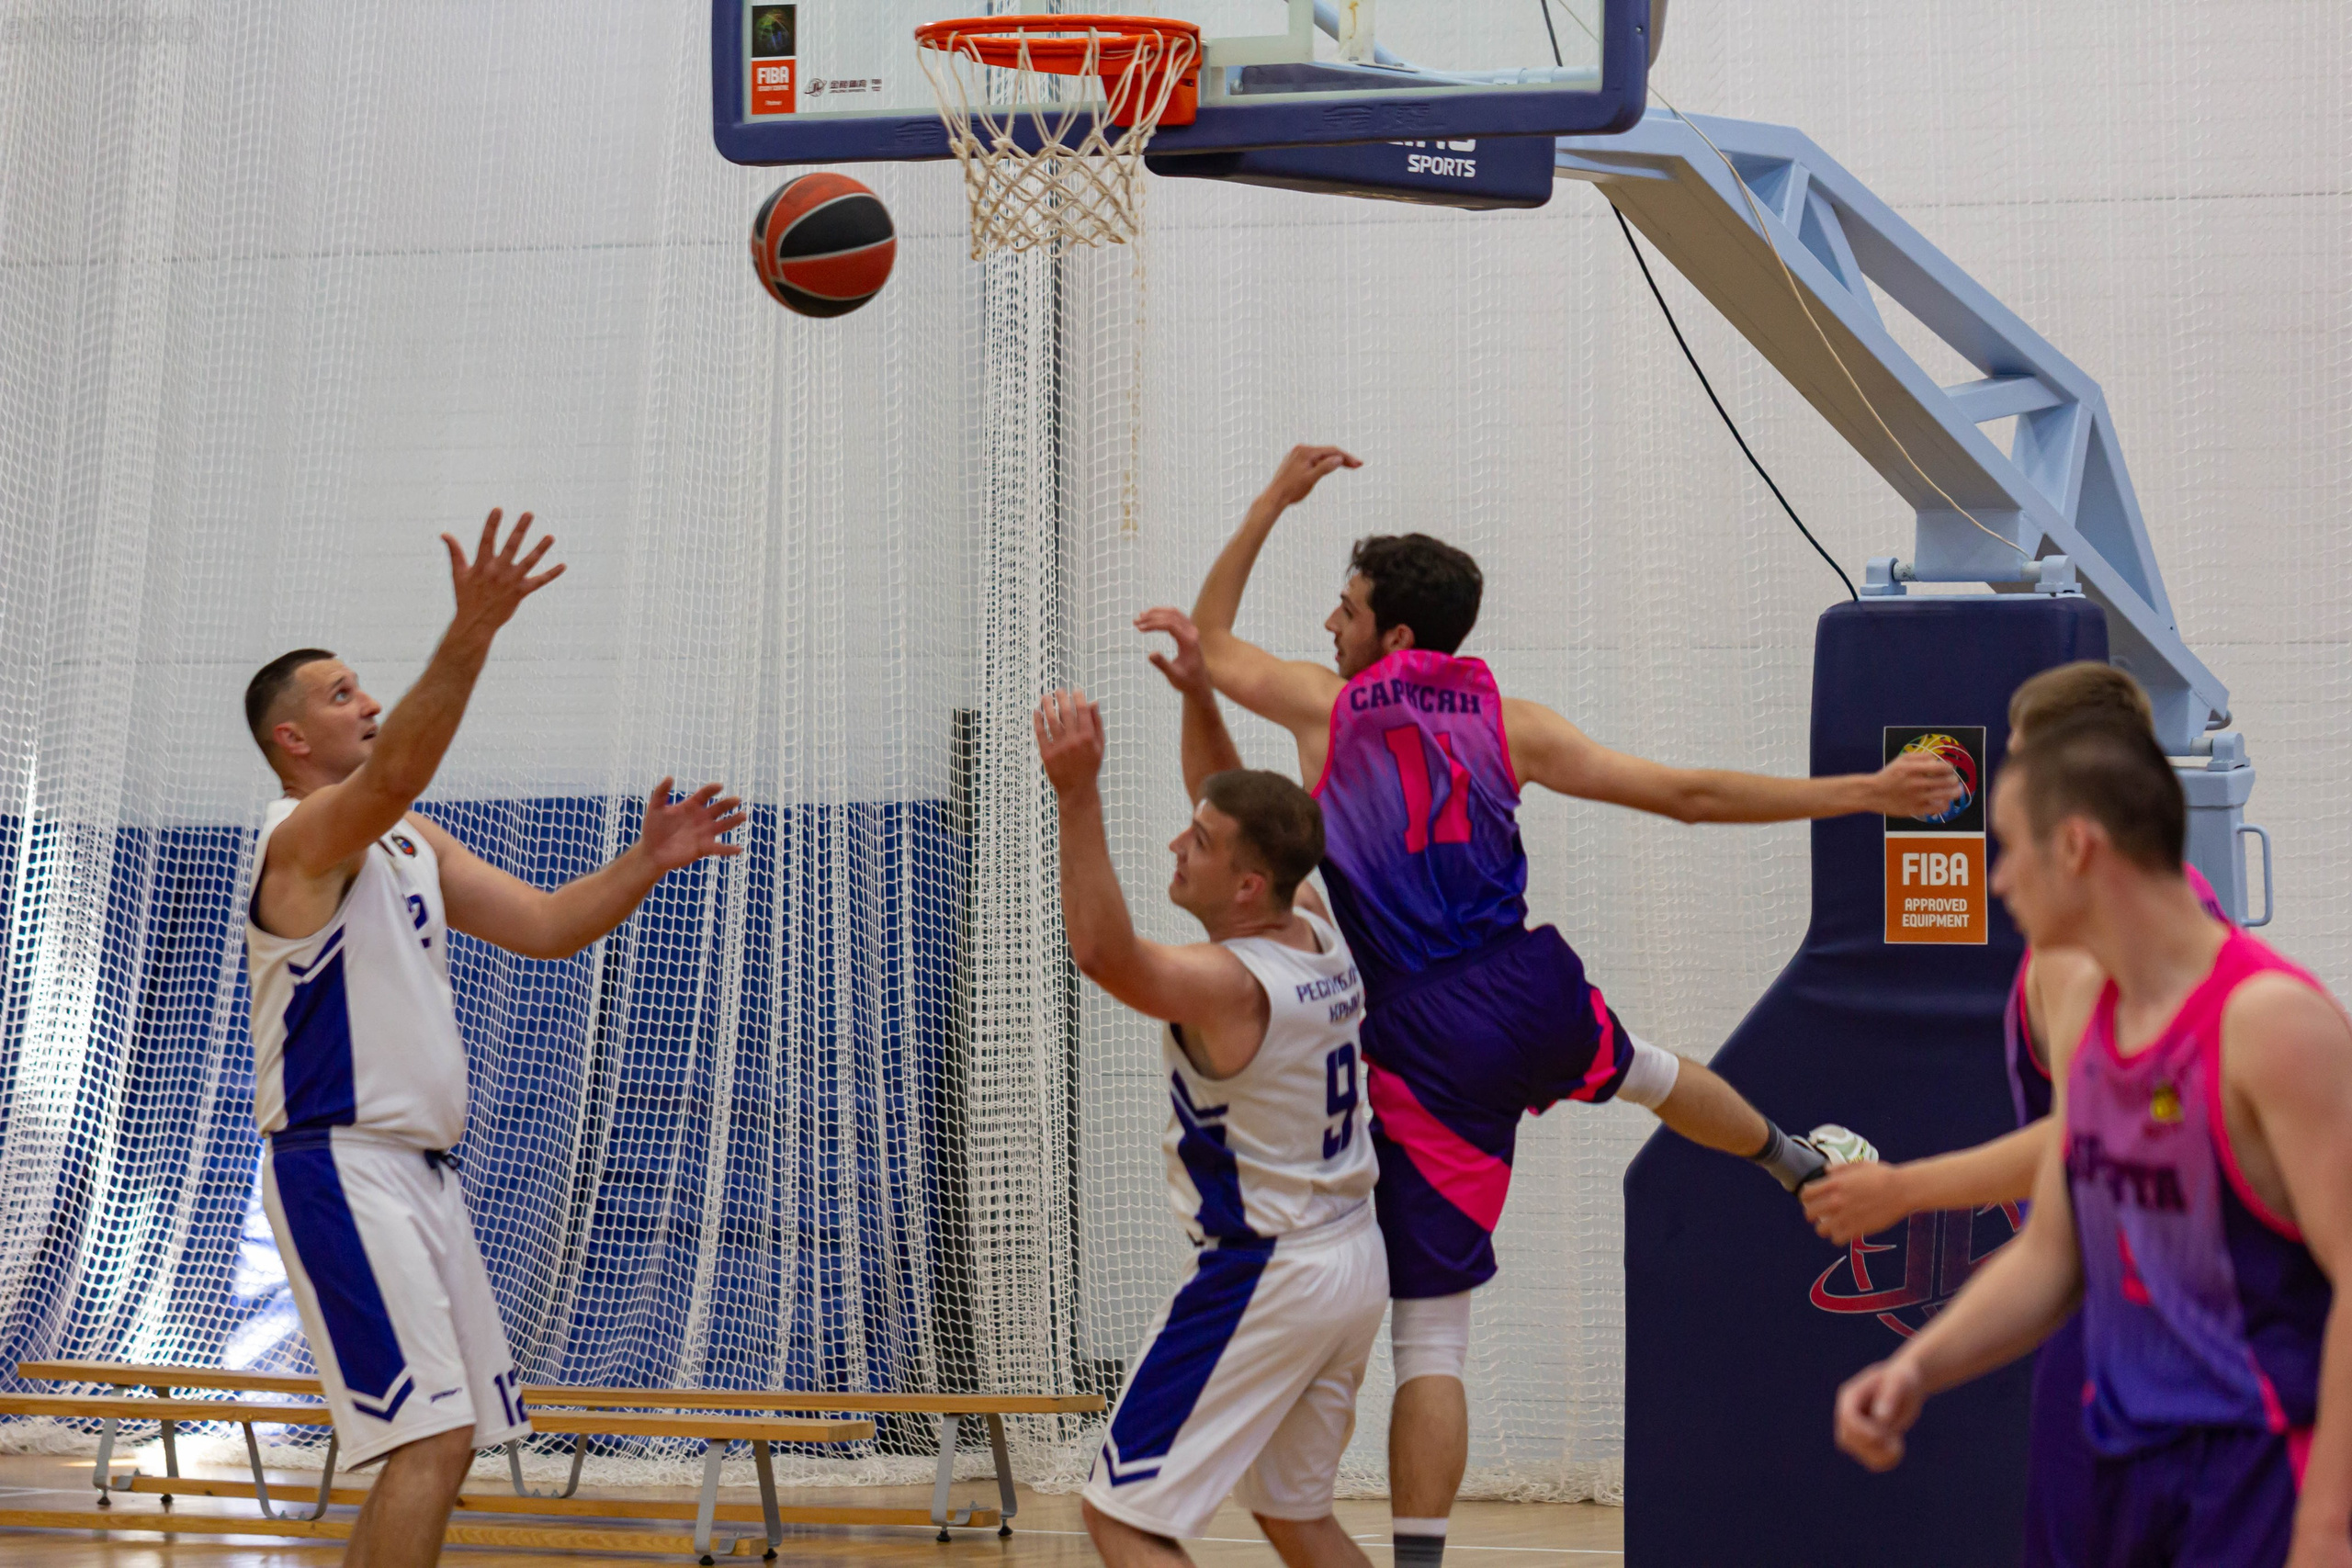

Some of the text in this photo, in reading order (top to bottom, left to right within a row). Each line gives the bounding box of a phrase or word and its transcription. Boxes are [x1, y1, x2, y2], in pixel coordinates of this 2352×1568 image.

[757, 66, 789, 85] FIBA
[1408, 154, 1476, 177] SPORTS
[1385, 722, 1472, 854] 11
[1902, 852, 1969, 886] FIBA
[1905, 898, 1968, 912] APPROVED
[1902, 914, 1969, 929] EQUIPMENT
[1323, 1043, 1358, 1160] 9
